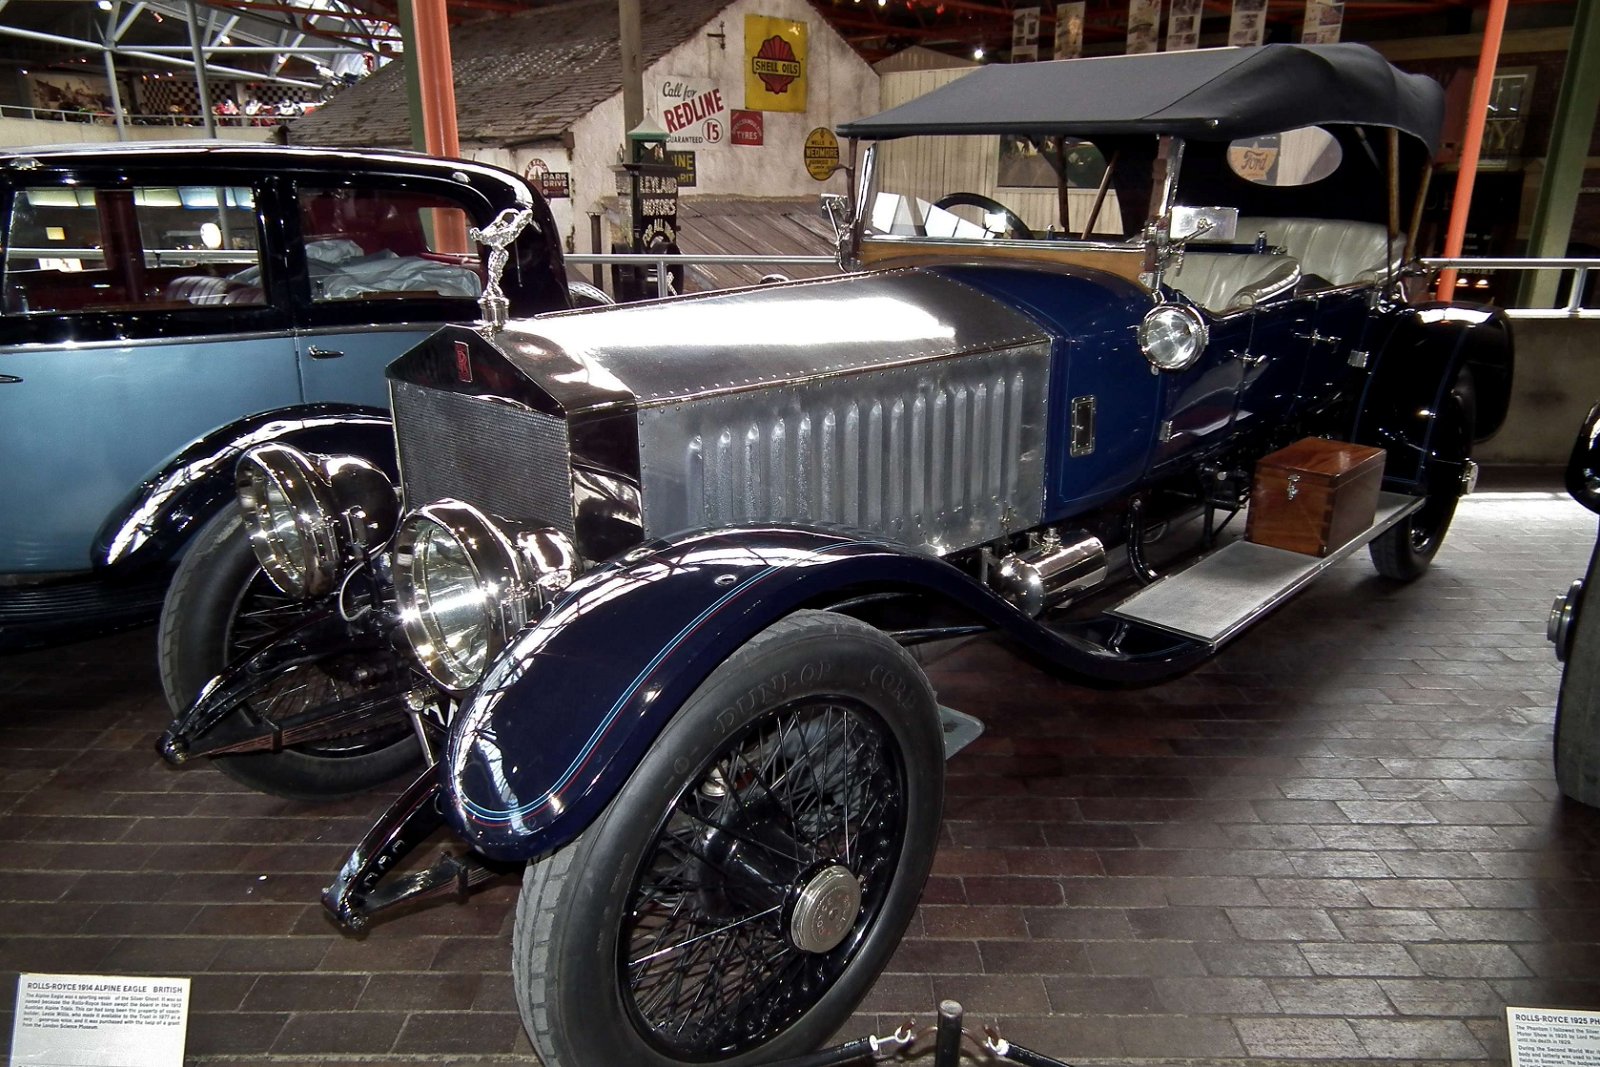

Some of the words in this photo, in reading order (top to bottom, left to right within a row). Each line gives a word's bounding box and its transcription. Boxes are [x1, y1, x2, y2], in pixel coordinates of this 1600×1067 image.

[755, 60, 779, 72] SHELL
[781, 63, 798, 74] OILS
[662, 81, 683, 98] Call
[682, 85, 698, 101] for
[663, 88, 725, 134] REDLINE
[737, 131, 758, 140] TYRES
[806, 147, 839, 158] WEDMORE
[1241, 150, 1268, 171] Ford
[543, 173, 568, 181] PARK
[639, 176, 678, 193] LEYLAND
[642, 198, 677, 216] MOTORS
[716, 662, 832, 735] DUNLOP
[27, 982, 77, 990] ROLLS-ROYCE
[94, 984, 122, 992] ALPINE
[123, 985, 148, 993] EAGLE
[1515, 1014, 1569, 1023] ROLLS-ROYCE
[1570, 1017, 1588, 1025] 1925
